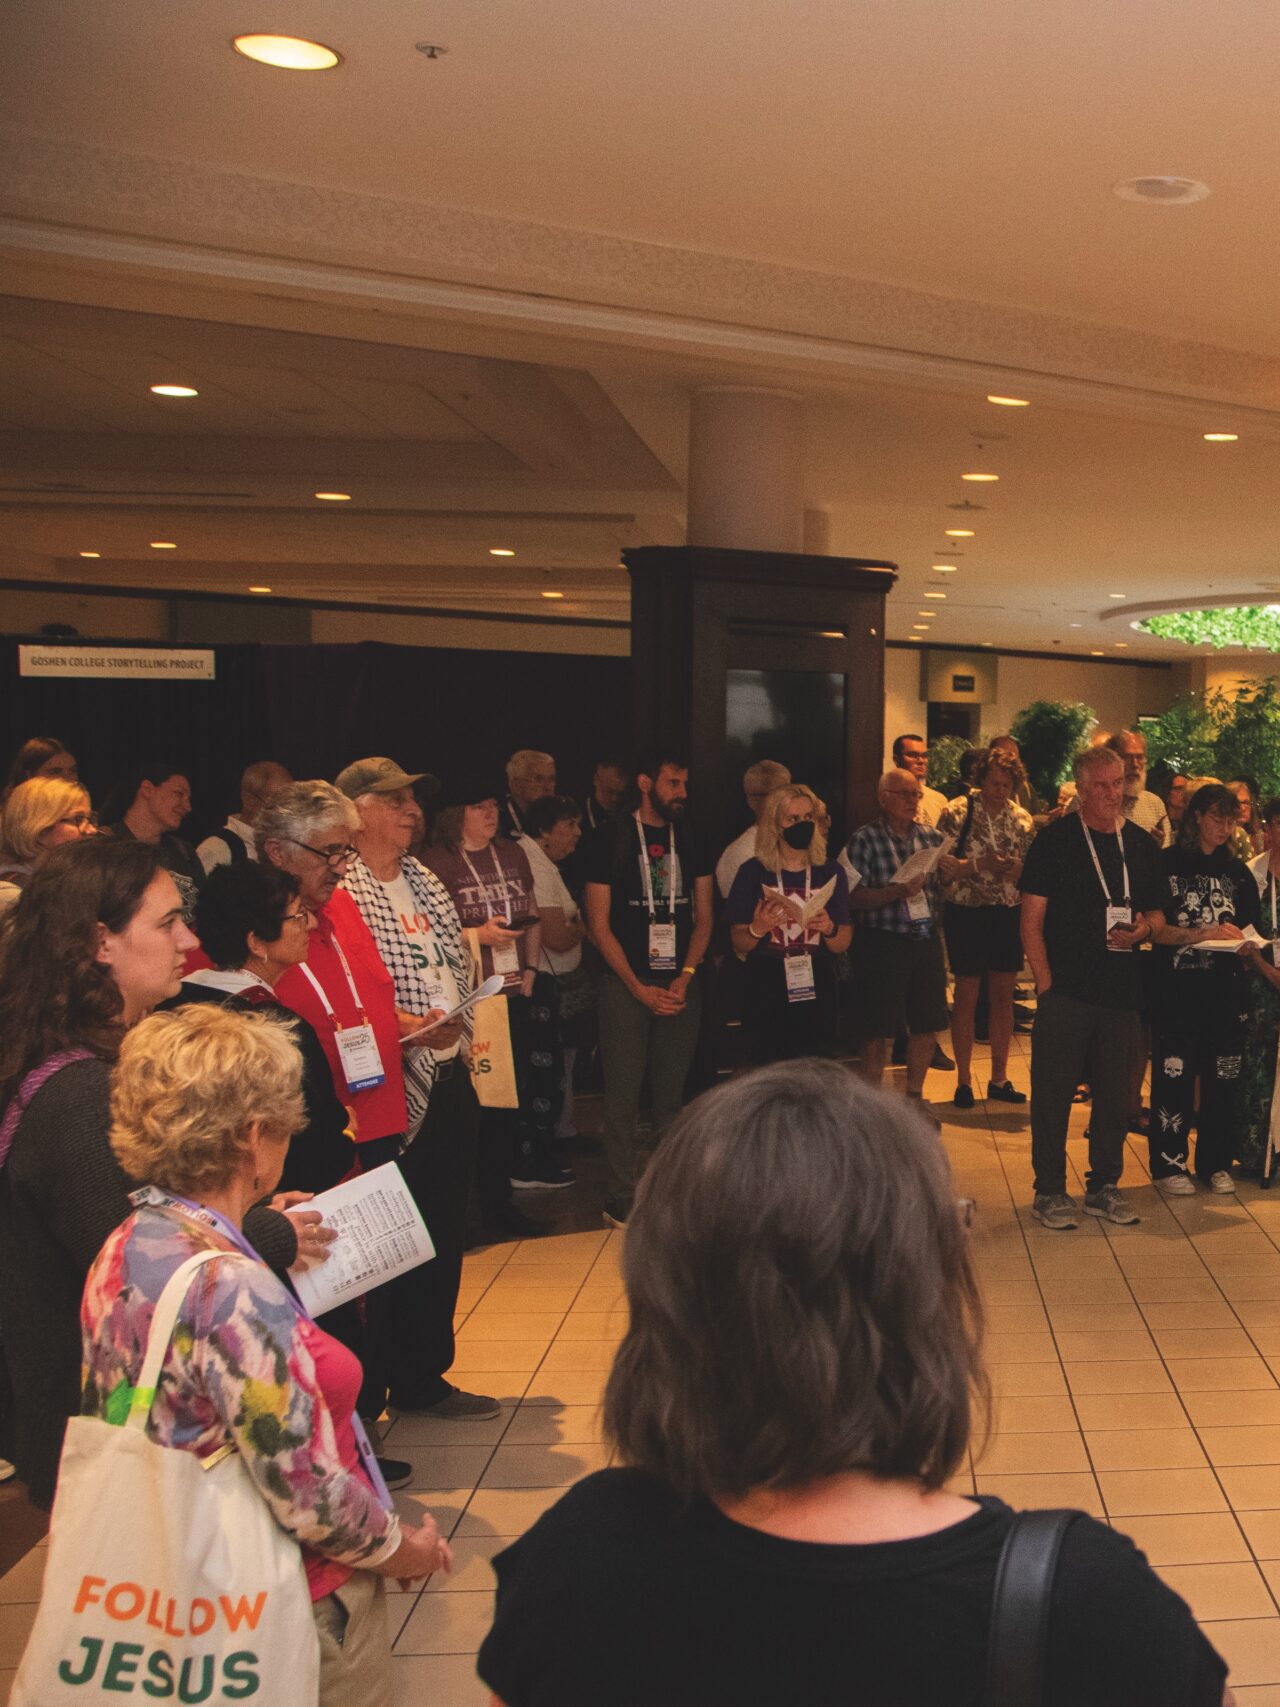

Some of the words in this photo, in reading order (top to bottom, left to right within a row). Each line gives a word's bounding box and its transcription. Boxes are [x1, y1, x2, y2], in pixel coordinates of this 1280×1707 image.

[30, 656, 67, 667] GOSHEN
[69, 657, 107, 668] COLLEGE
[108, 658, 168, 669] STORYTELLING
[169, 659, 204, 670] PROJECT
[73, 1575, 269, 1638] FOLLOW
[58, 1636, 261, 1705] JESUS
